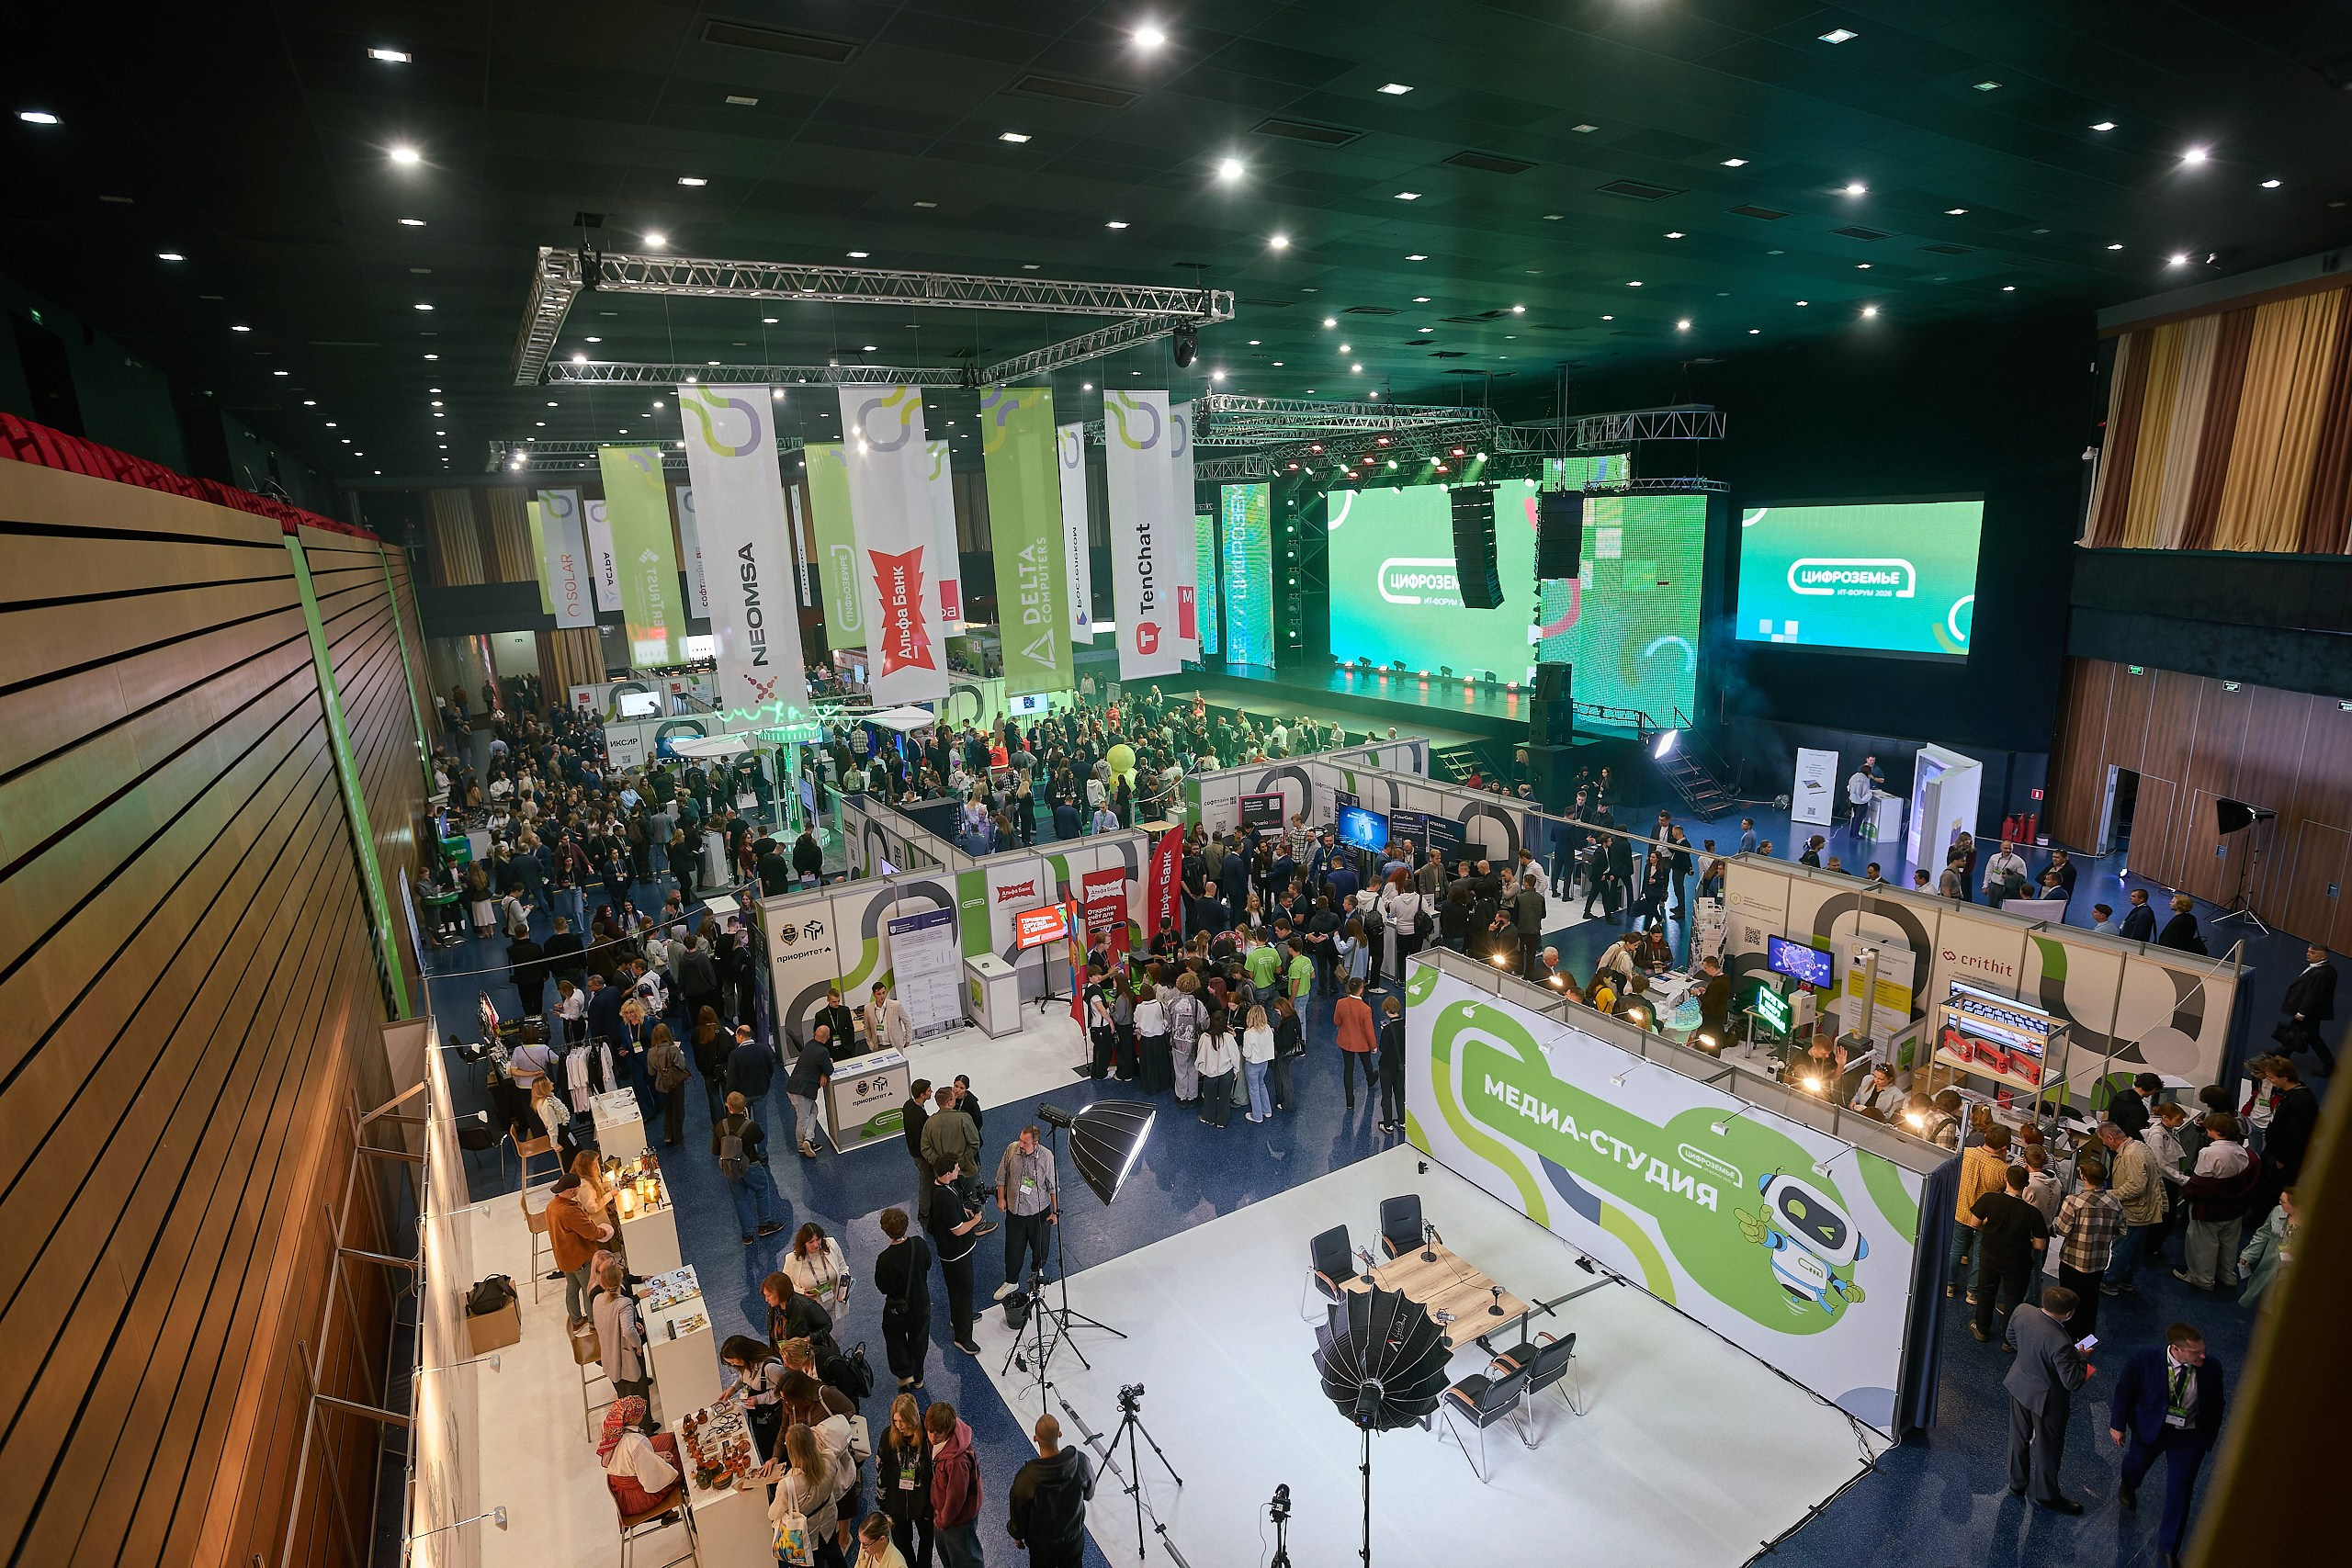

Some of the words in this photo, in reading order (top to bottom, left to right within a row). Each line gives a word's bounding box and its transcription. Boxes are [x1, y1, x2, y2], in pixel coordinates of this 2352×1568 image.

[560, 553, 578, 601] SOLAR
[1017, 544, 1041, 626] DELTA
[1036, 536, 1053, 624] COMPUTERS
[1136, 523, 1155, 615] TenChat
[1390, 573, 1461, 591] ЦИФРОЗЕМ
[1802, 570, 1900, 585] ЦИФРОЗЕМЬЕ
[892, 565, 907, 606] Банк
[1424, 597, 1458, 606] ИТ-ФОРУМ
[1837, 589, 1873, 597] ИТ-ФОРУМ
[738, 542, 769, 667] NEOMSA
[896, 607, 913, 660] Альфа
[1160, 850, 1171, 886] Банк
[1087, 905, 1117, 915] Откройте
[1160, 885, 1171, 919] льфа
[1088, 917, 1114, 927] бизнеса
[776, 948, 823, 963] приоритет
[1962, 954, 2013, 976] crithit
[853, 1093, 888, 1107] приоритет
[1484, 1073, 1718, 1213] МЕДИА-СТУДИЯ
[1685, 1149, 1736, 1179] ЦИФРОЗЕМЬЕ
